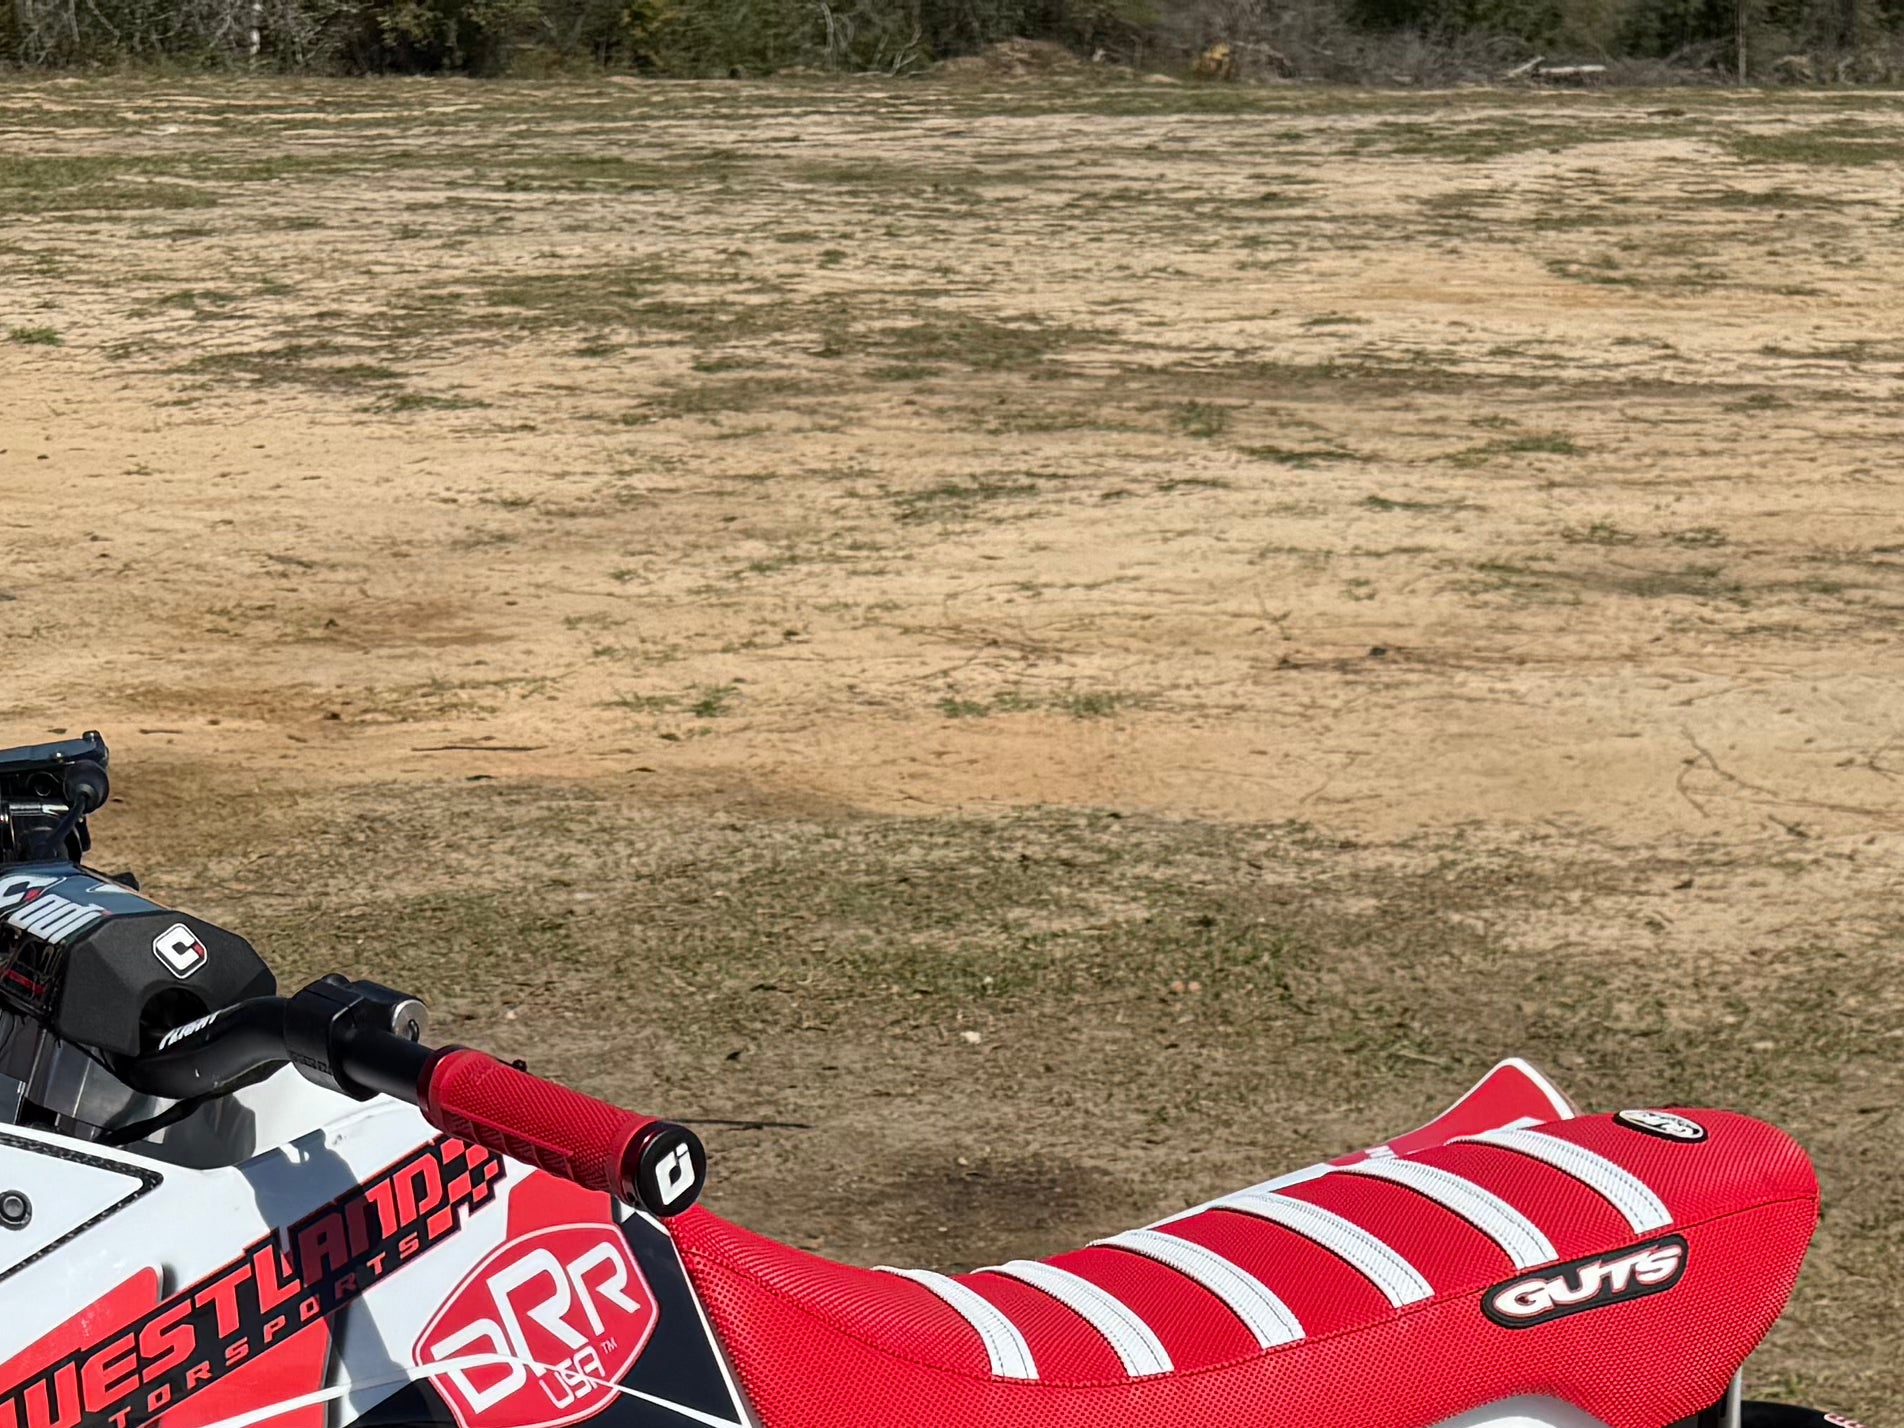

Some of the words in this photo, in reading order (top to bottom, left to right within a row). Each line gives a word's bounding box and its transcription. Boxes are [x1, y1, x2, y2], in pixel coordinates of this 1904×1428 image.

[1494, 1245, 1682, 1319] GUTS
[431, 1240, 641, 1414] DRR
[539, 1348, 606, 1410] USA
